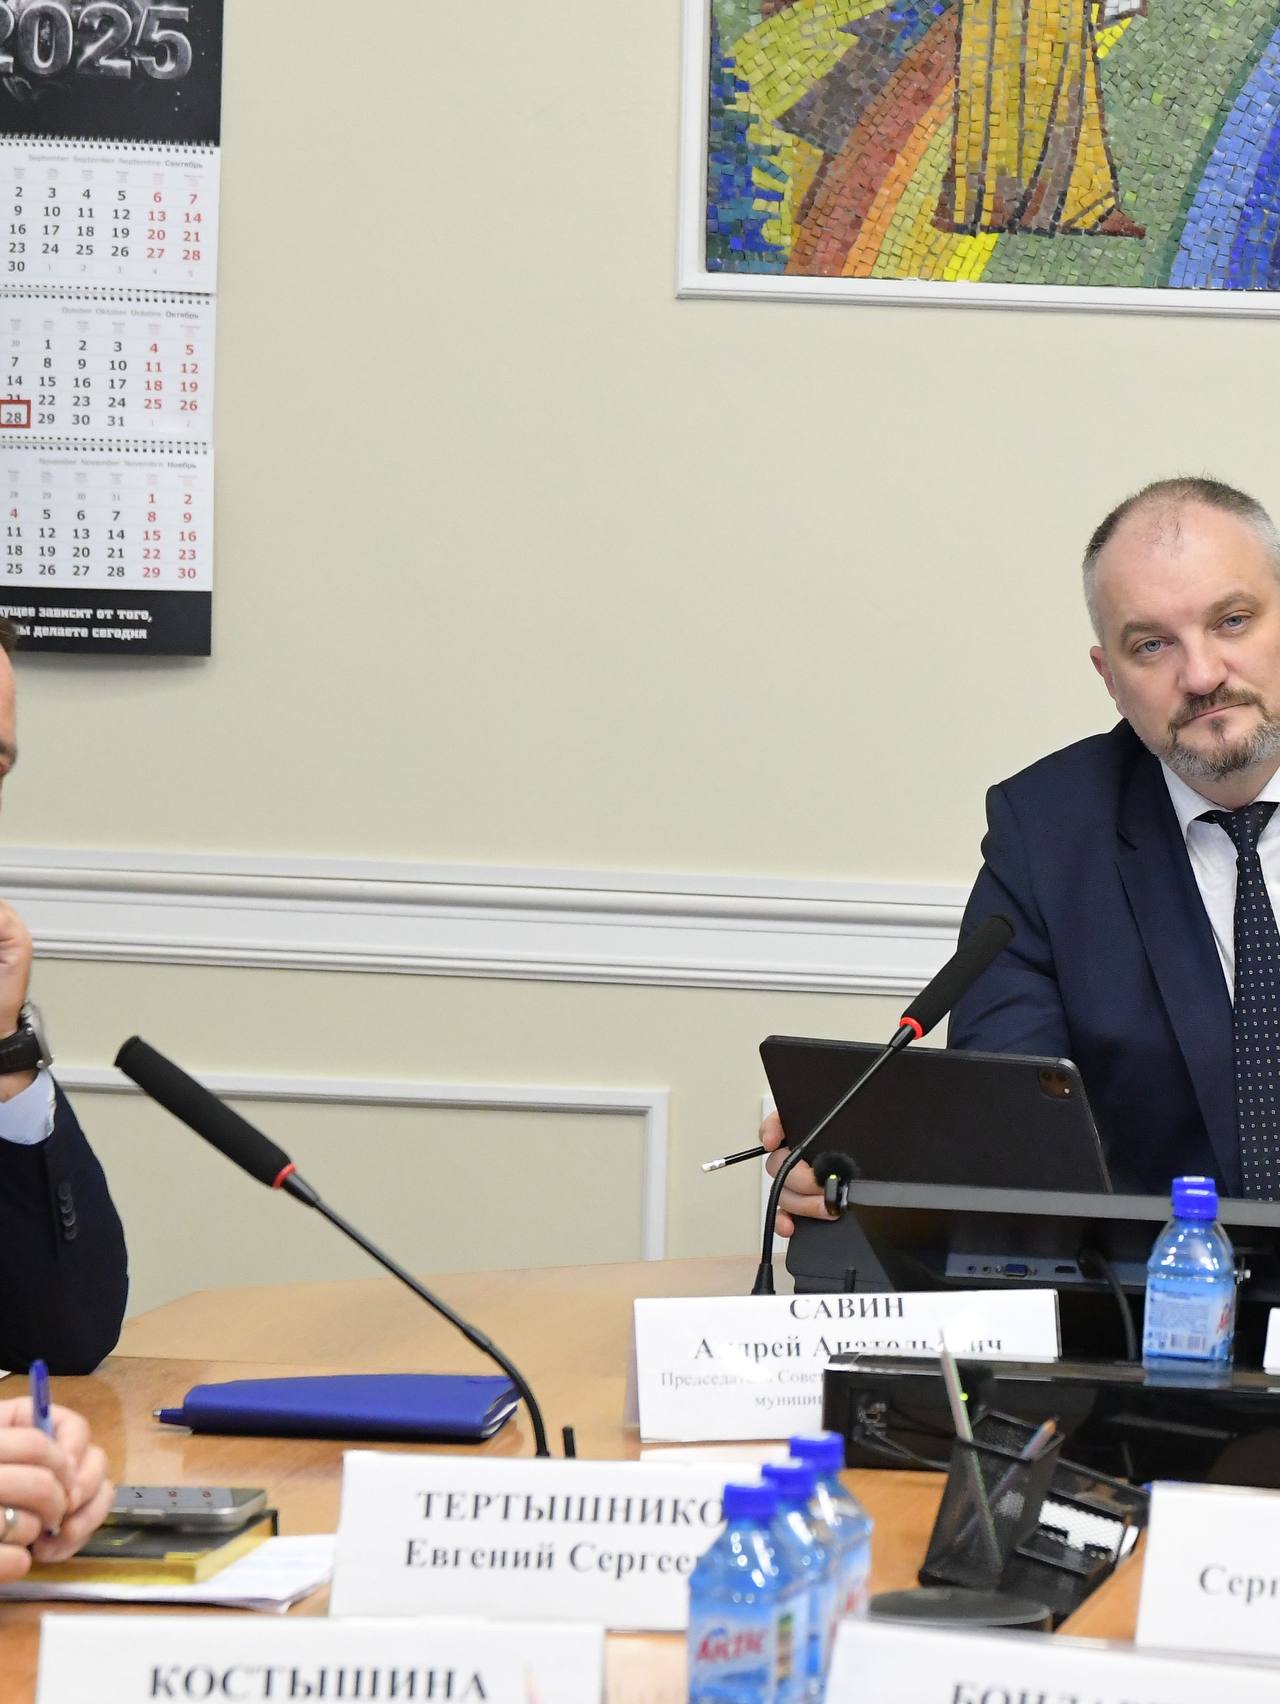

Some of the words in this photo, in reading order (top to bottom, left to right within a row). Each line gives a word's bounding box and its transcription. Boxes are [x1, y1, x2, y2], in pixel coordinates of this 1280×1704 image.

[0, 1, 193, 80] 025
[15, 186, 23, 198] 2
[47, 186, 57, 199] 3
[82, 188, 91, 200] 4
[117, 189, 127, 202] 5
[153, 191, 163, 204] 6
[189, 193, 198, 205] 7
[13, 204, 23, 217] 9
[43, 205, 61, 217] 10
[77, 207, 95, 219] 11
[112, 208, 131, 221] 12
[148, 210, 167, 223] 13
[184, 212, 202, 224] 14
[9, 223, 27, 235] 16
[42, 224, 60, 236] 17
[77, 225, 95, 238] 18
[112, 227, 130, 239] 19
[147, 228, 166, 241] 20
[183, 230, 201, 243] 21
[8, 241, 26, 254] 23
[41, 242, 60, 255] 24
[75, 243, 94, 256] 25
[111, 245, 130, 258] 26
[146, 247, 165, 259] 27
[182, 249, 201, 261] 28
[7, 260, 26, 273] 30
[45, 338, 52, 350] 1
[78, 339, 87, 352] 2
[113, 340, 123, 353] 3
[149, 342, 159, 354] 4
[185, 344, 195, 356] 5
[11, 356, 20, 368] 7
[43, 356, 52, 369] 8
[77, 358, 87, 370] 9
[109, 359, 128, 372] 10
[145, 361, 163, 373] 11
[181, 362, 199, 374] 12
[7, 375, 23, 387] 14
[39, 375, 57, 388] 15
[73, 376, 92, 389] 16
[108, 378, 127, 390] 17
[144, 379, 163, 392] 18
[180, 381, 199, 393] 19
[38, 394, 56, 406] 22
[72, 395, 91, 408] 23
[107, 396, 127, 409] 24
[144, 398, 162, 410] 25
[179, 399, 198, 412] 26
[5, 412, 22, 423] 28
[37, 412, 56, 425] 29
[71, 413, 91, 426] 30
[107, 415, 125, 427] 31
[148, 493, 156, 504] 1
[184, 493, 192, 505] 2
[10, 507, 18, 519] 4
[42, 508, 52, 520] 5
[76, 509, 86, 521] 6
[111, 510, 121, 522] 7
[147, 511, 157, 523] 8
[183, 512, 193, 524] 9
[7, 525, 23, 538] 11
[39, 527, 56, 539] 12
[73, 527, 91, 540] 13
[107, 529, 126, 541] 14
[143, 530, 161, 542] 15
[179, 530, 197, 542] 16
[6, 544, 24, 557] 18
[39, 545, 56, 558] 19
[72, 546, 91, 559] 20
[106, 547, 125, 559] 21
[142, 548, 161, 560] 22
[178, 549, 197, 561] 23
[6, 562, 23, 575] 25
[38, 563, 57, 576] 26
[72, 564, 91, 577] 27
[106, 565, 126, 578] 28
[143, 566, 161, 578] 29
[178, 567, 197, 579] 30
[96, 609, 114, 619] от
[116, 609, 152, 622] того,
[789, 1297, 904, 1320] САВИН
[694, 1335, 801, 1363] Арей
[416, 1491, 725, 1528] ТЕРТЫШНИКО
[404, 1538, 556, 1569] Евгений
[568, 1542, 699, 1580] Сергее
[151, 1665, 488, 1701] КОСТЫШИНА
